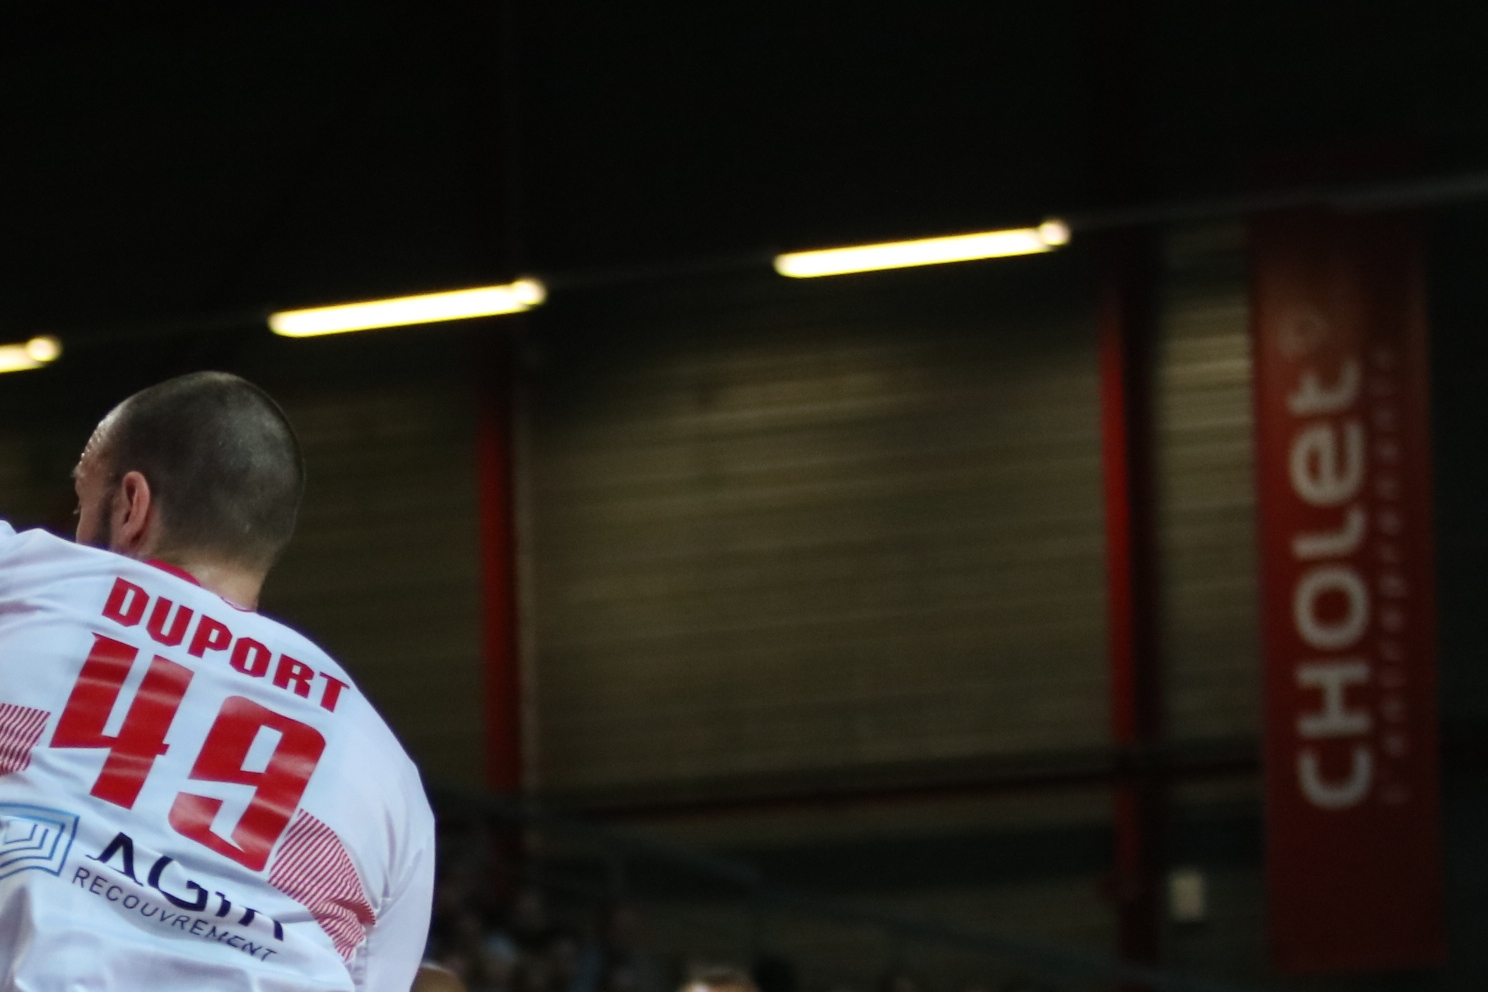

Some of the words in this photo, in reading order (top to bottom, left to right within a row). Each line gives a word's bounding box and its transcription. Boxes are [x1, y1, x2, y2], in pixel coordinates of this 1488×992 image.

[102, 577, 350, 713] DUPORT
[49, 632, 326, 872] 49
[73, 867, 277, 961] RECOUVREMENT
